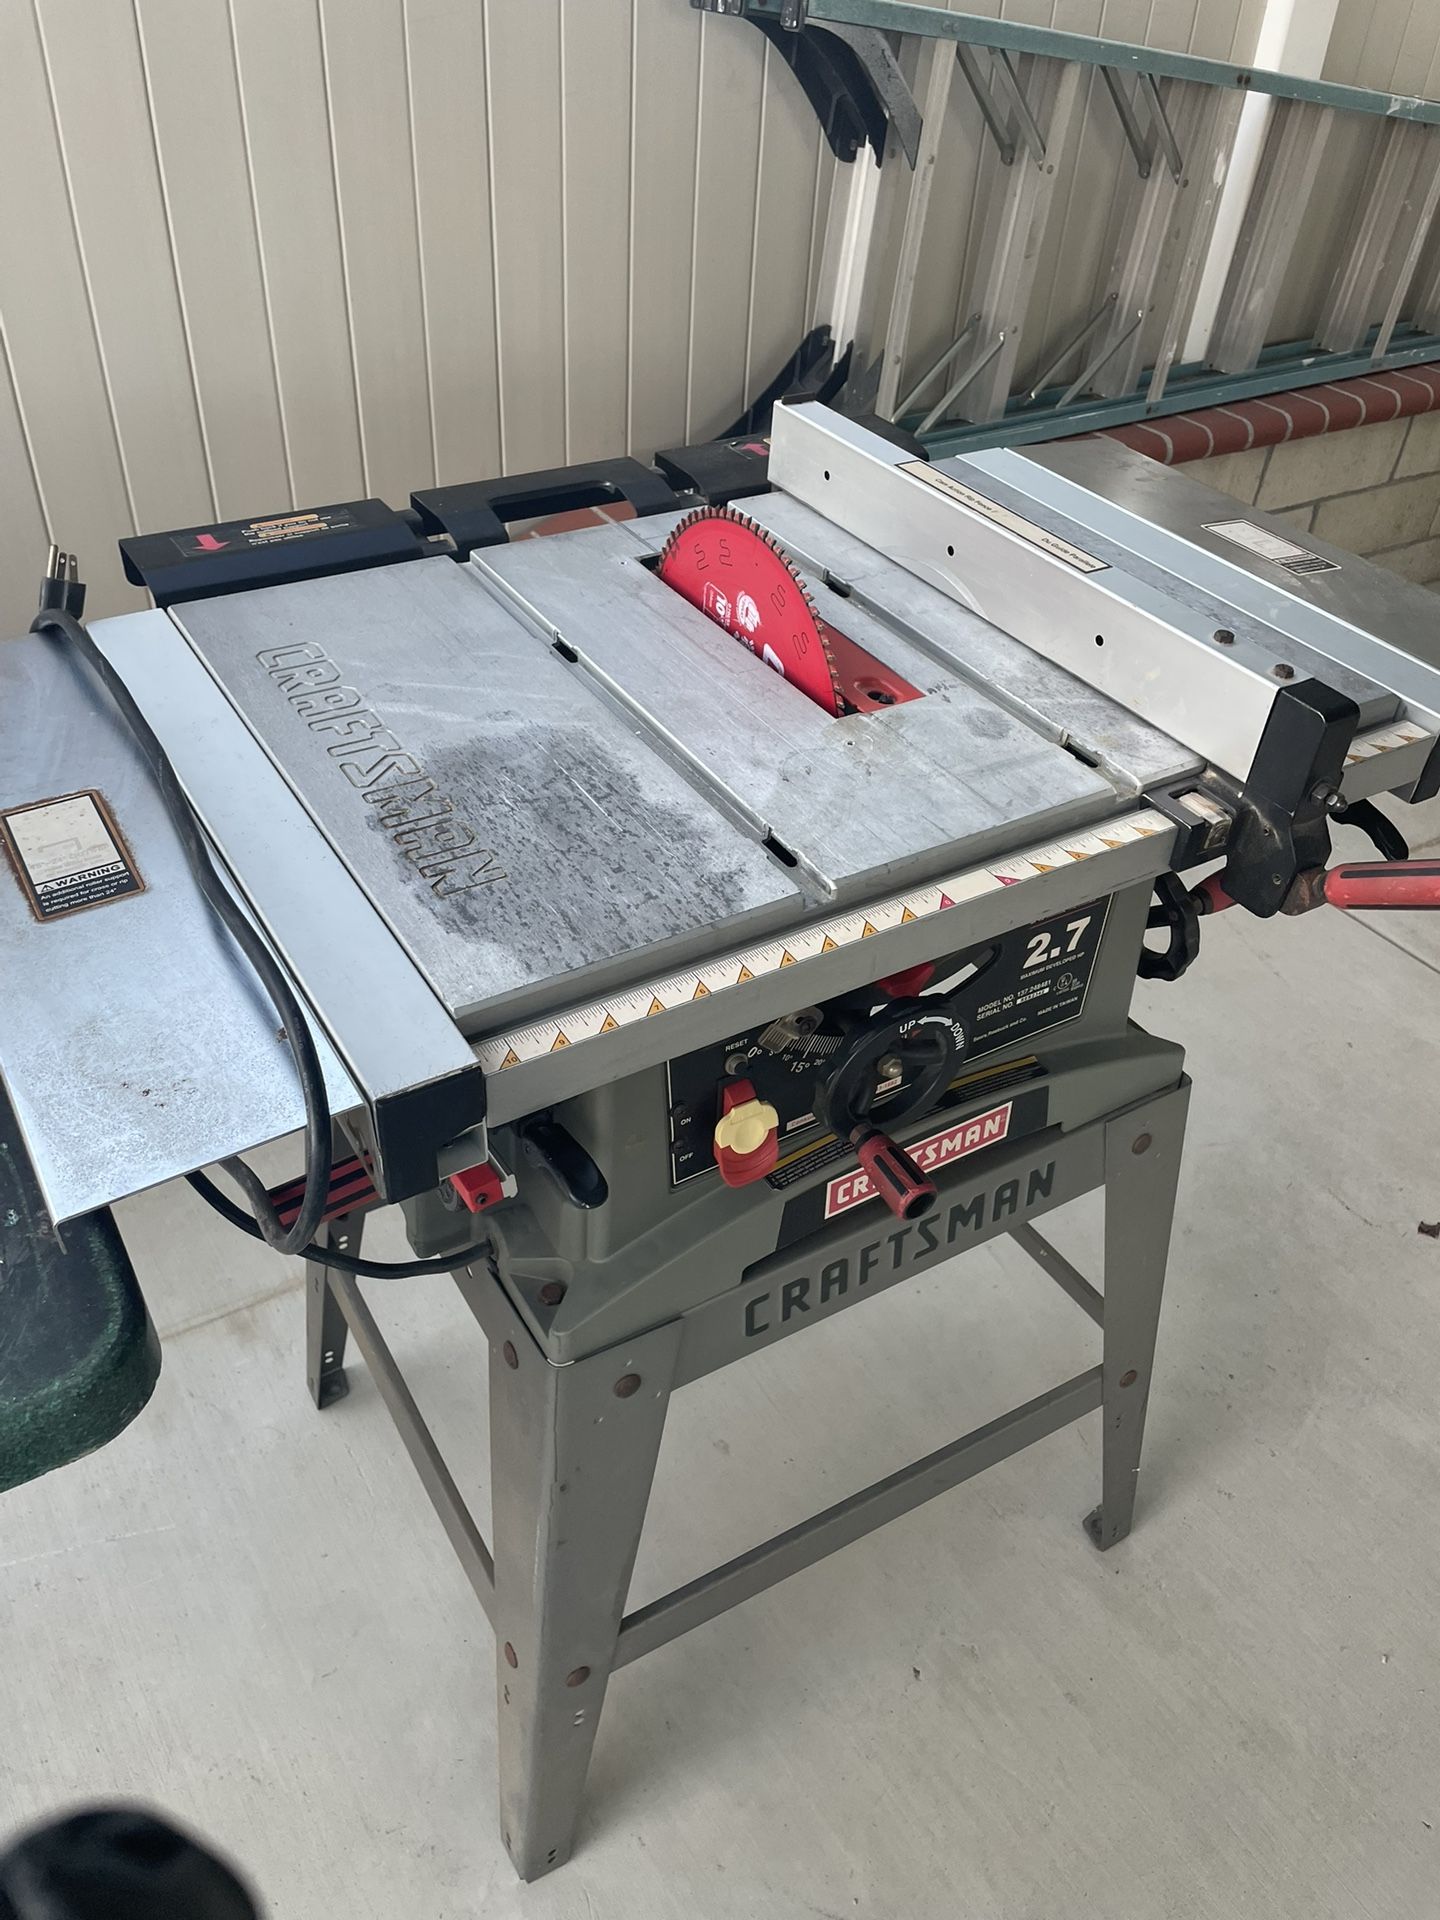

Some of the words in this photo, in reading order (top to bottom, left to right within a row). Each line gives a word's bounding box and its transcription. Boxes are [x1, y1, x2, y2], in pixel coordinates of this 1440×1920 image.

[256, 642, 507, 898] CRAFTSMAN
[52, 885, 85, 897] additional
[86, 879, 102, 887] roller
[104, 872, 130, 882] support
[56, 865, 120, 887] WARNING
[45, 902, 69, 913] cutting
[70, 897, 87, 905] more
[89, 891, 104, 899] than
[51, 892, 79, 905] required
[1023, 915, 1091, 969] 2.7
[976, 1007, 1001, 1021] SERIAL
[978, 1000, 1001, 1013] MODEL
[900, 1020, 916, 1034] UP
[951, 1022, 965, 1051] DOWN
[725, 1039, 748, 1052] RESET
[790, 1061, 810, 1073] 15°
[680, 1117, 692, 1126] ON
[680, 1152, 694, 1162] OFF
[745, 1161, 1056, 1337] CRAFTSMAN
